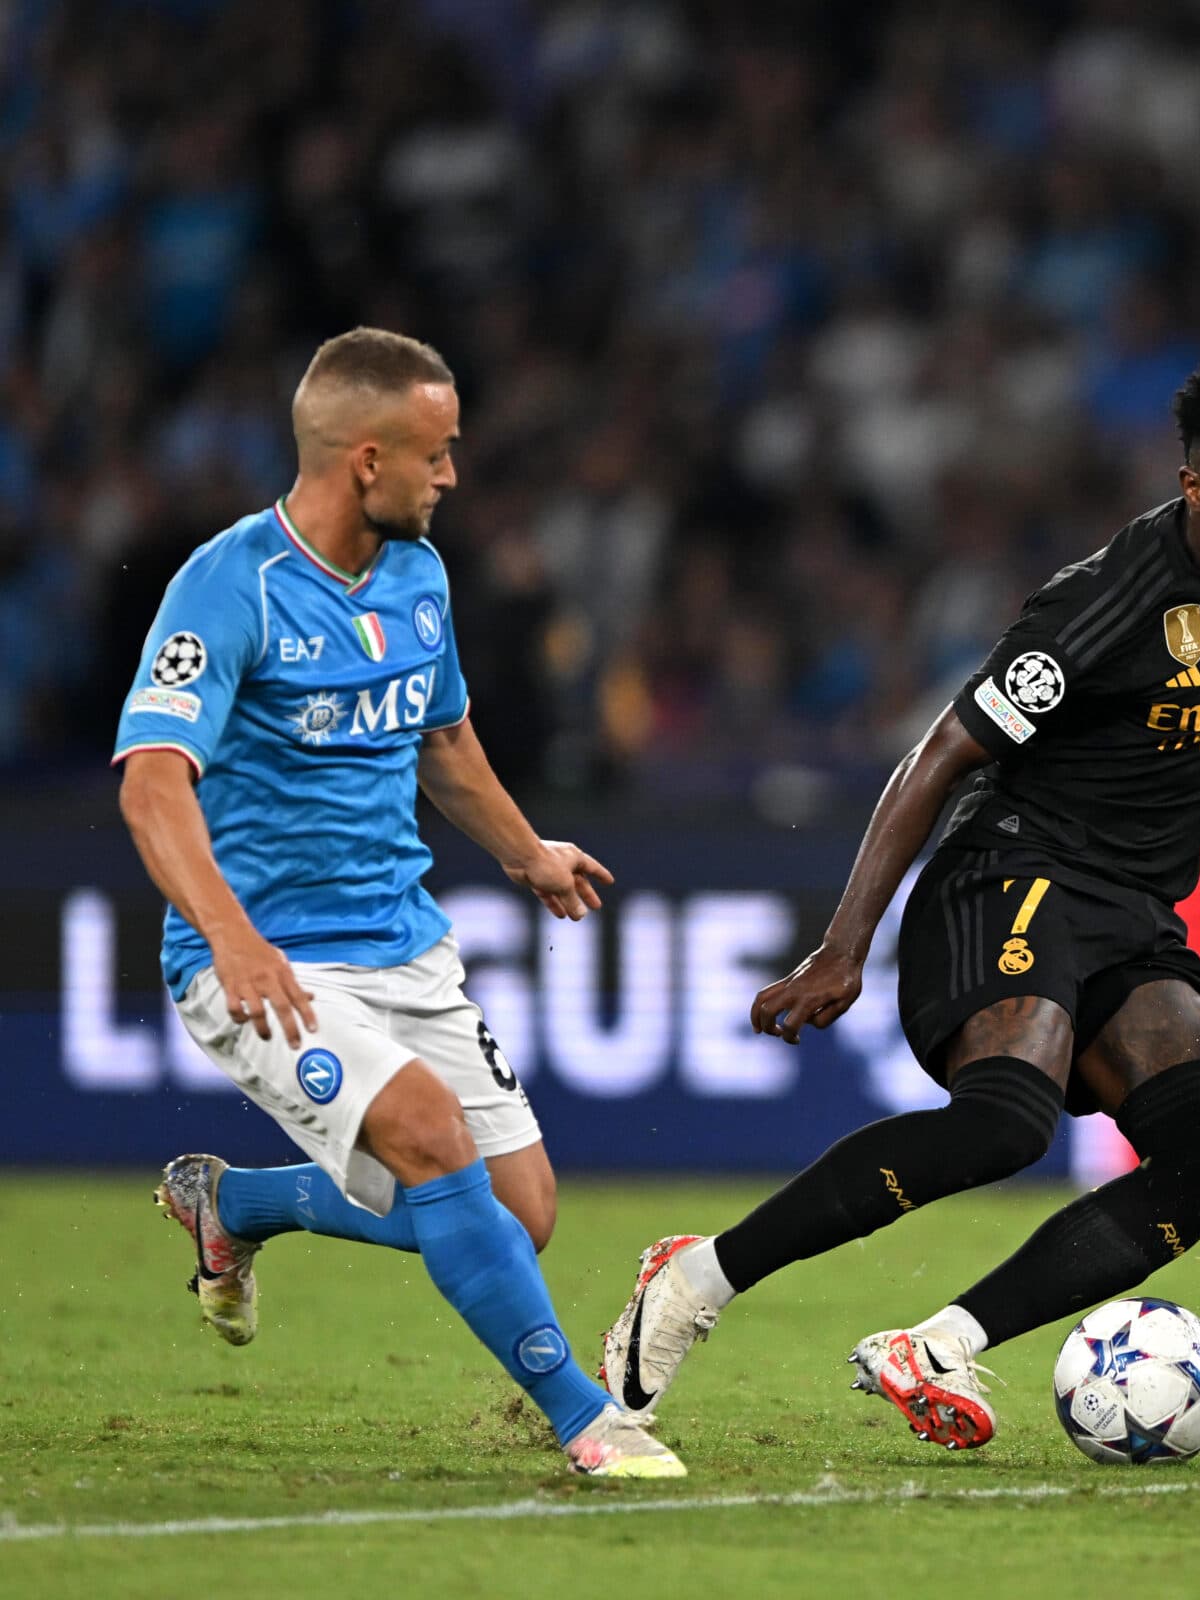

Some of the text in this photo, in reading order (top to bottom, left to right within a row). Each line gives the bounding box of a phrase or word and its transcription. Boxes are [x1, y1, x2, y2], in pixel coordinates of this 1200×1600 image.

[418, 609, 436, 638] N
[280, 635, 324, 662] EA7
[1180, 642, 1198, 652] FIFA
[349, 665, 436, 736] MS
[1003, 878, 1050, 934] 7
[60, 890, 798, 1098] LGUE
[304, 1059, 331, 1093] N
[880, 1167, 918, 1211] RM
